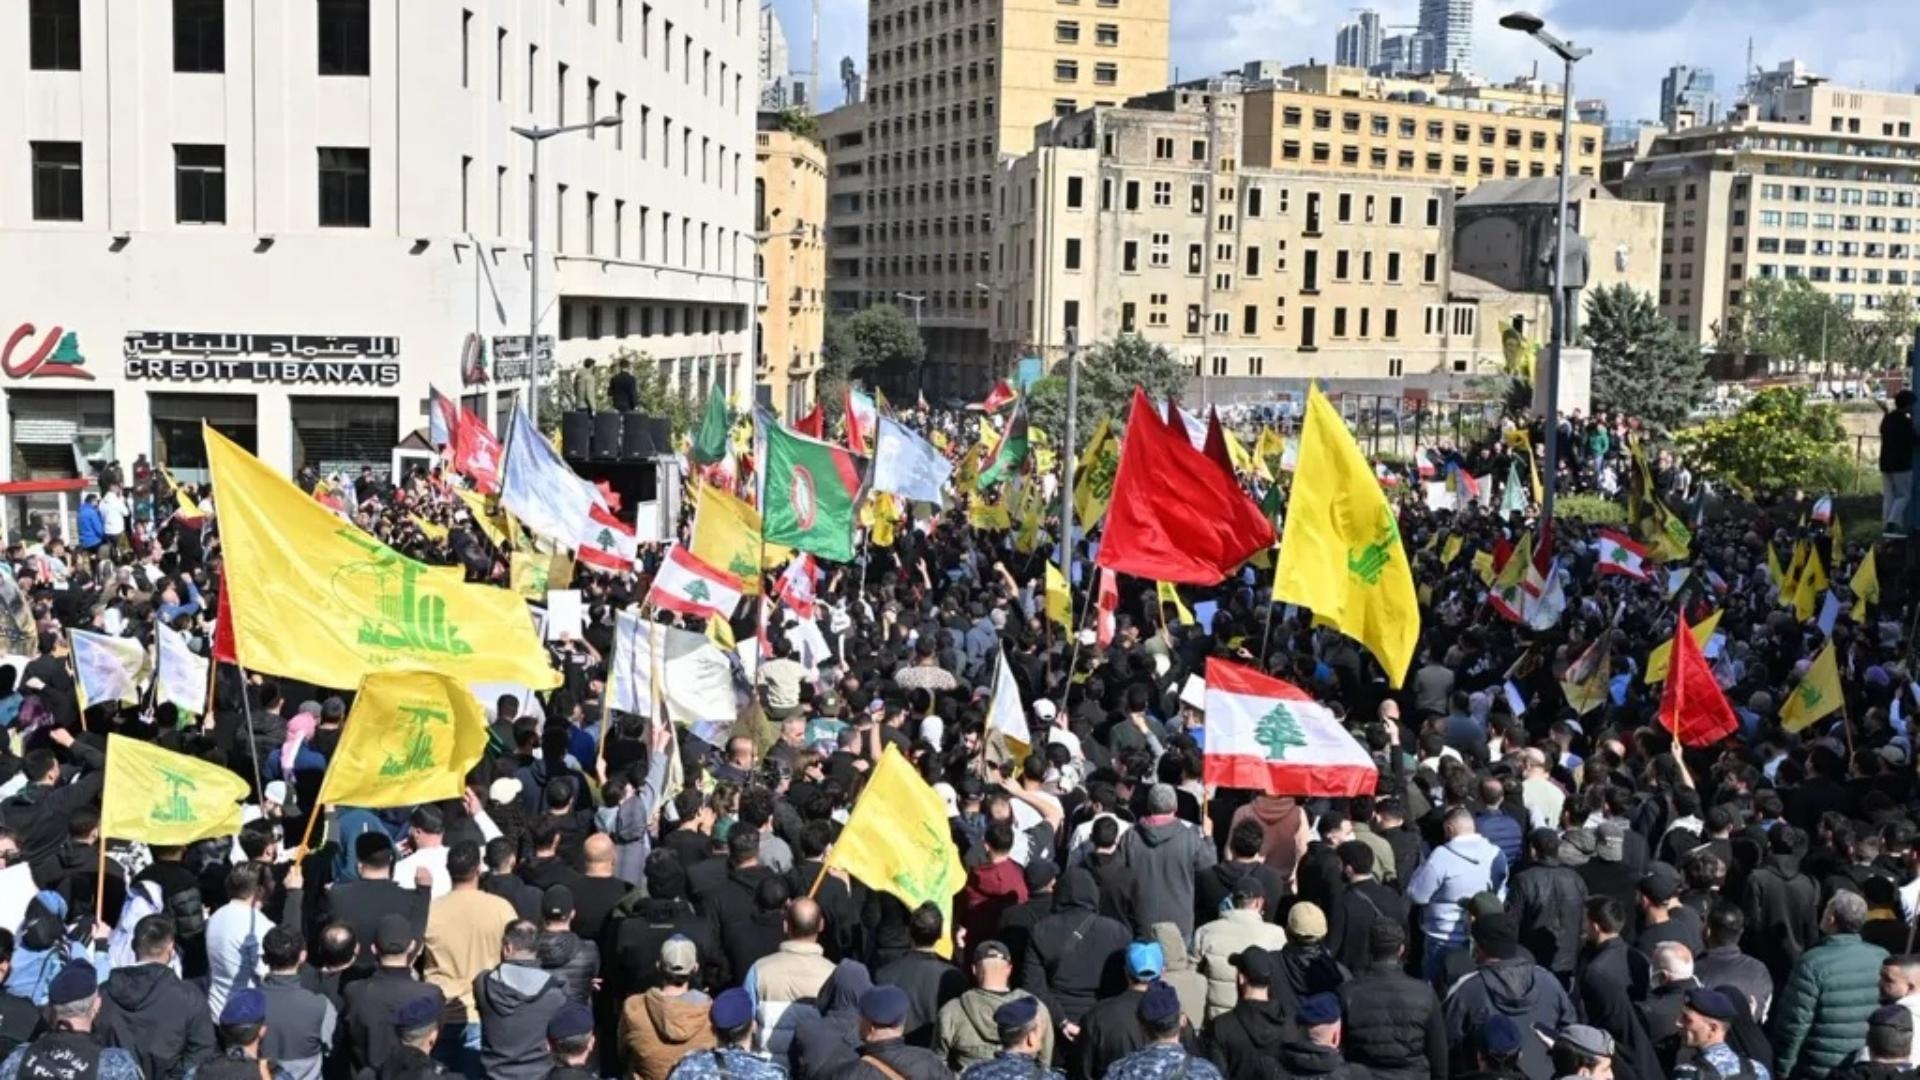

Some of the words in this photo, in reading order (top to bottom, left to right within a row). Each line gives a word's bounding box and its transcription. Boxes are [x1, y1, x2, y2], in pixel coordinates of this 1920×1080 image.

[124, 332, 253, 358] اللبناني
[270, 335, 399, 356] الاعتماد
[126, 359, 240, 378] CREDIT
[252, 362, 399, 383] LIBANAIS
